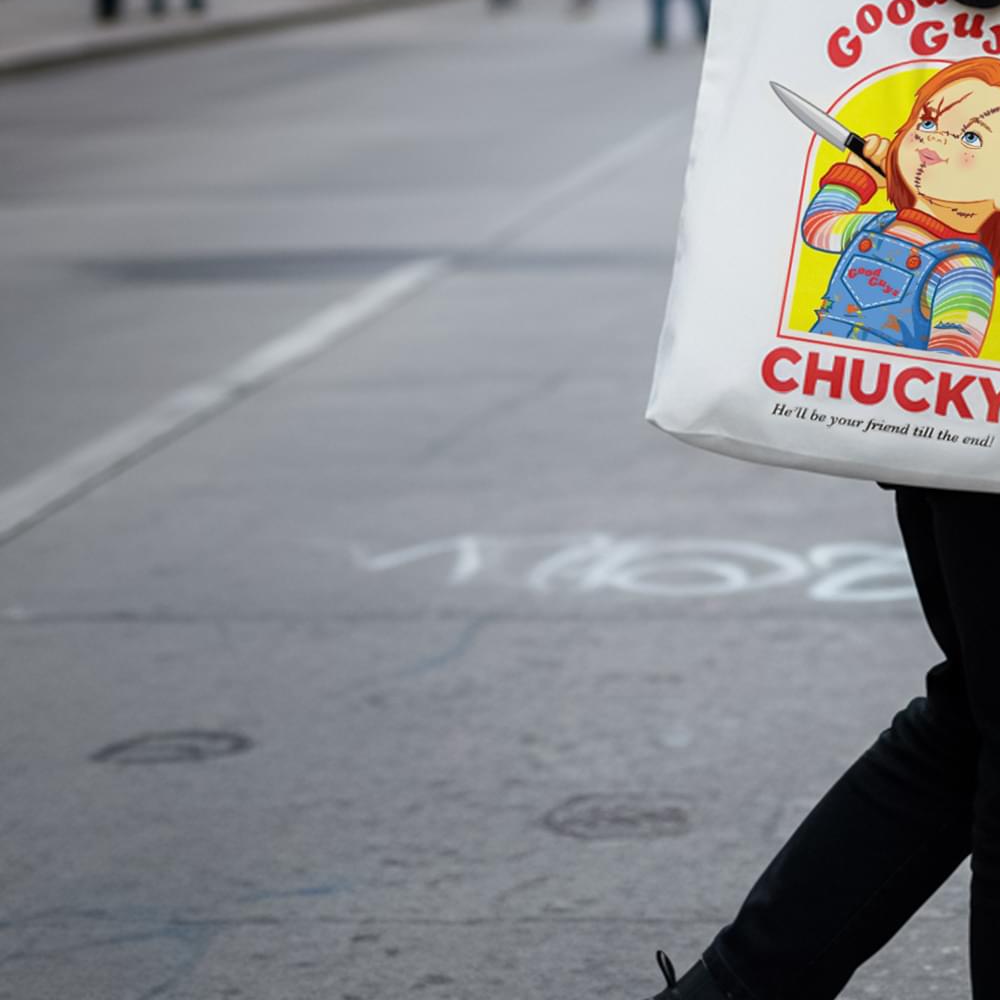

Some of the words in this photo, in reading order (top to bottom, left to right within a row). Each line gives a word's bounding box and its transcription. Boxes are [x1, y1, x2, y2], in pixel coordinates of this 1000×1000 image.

[772, 403, 808, 420] He'll
[810, 409, 827, 422] be
[826, 415, 864, 428] your
[862, 418, 910, 435] friend
[912, 425, 935, 439] till
[937, 429, 959, 443] the
[962, 433, 996, 448] end!
